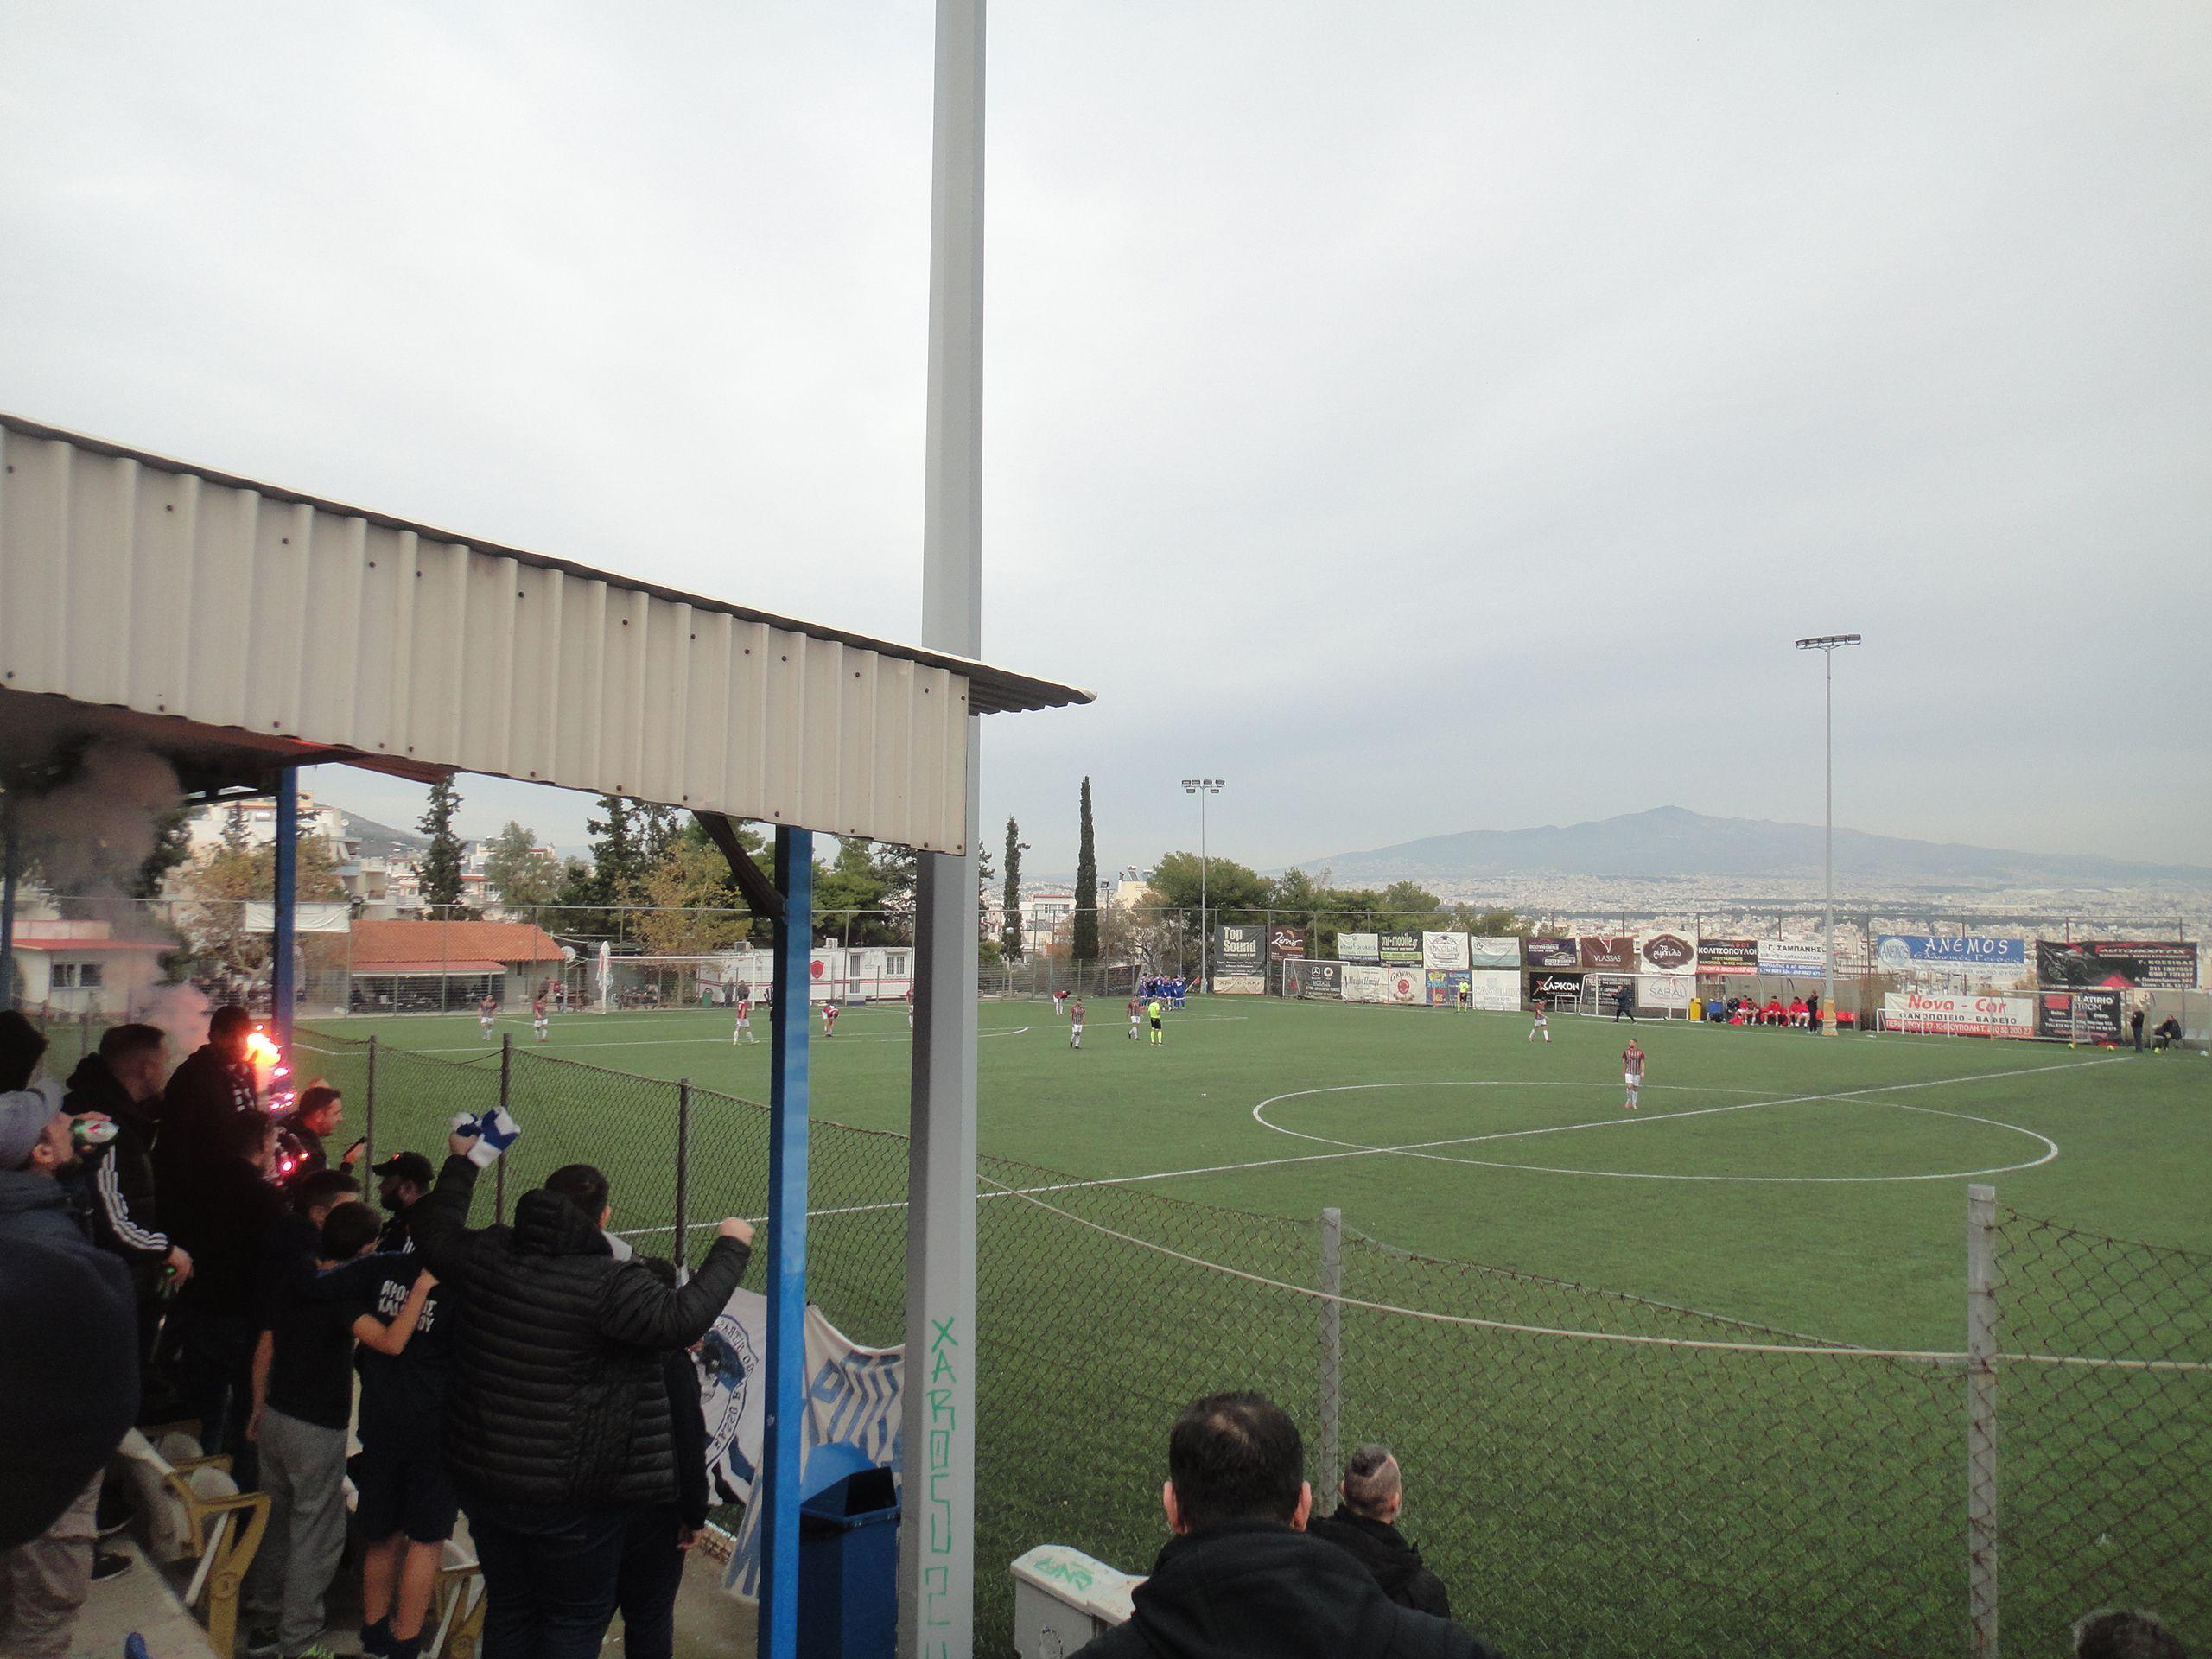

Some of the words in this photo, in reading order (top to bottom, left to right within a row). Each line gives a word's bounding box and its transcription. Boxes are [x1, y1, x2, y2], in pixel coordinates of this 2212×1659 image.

[1223, 926, 1243, 941] Top
[1223, 939, 1256, 953] Sound
[1699, 947, 1758, 956] ΚΟΛΙΤΣΟΠΟΥΛΟΙ
[1777, 944, 1821, 953] ΣΑΜΠΑΝΗΣ
[1881, 943, 1909, 960] ANEMOS
[1924, 938, 2008, 955] ANEMOS
[1908, 995, 1955, 1011] Nova
[1975, 998, 2007, 1014] Car
